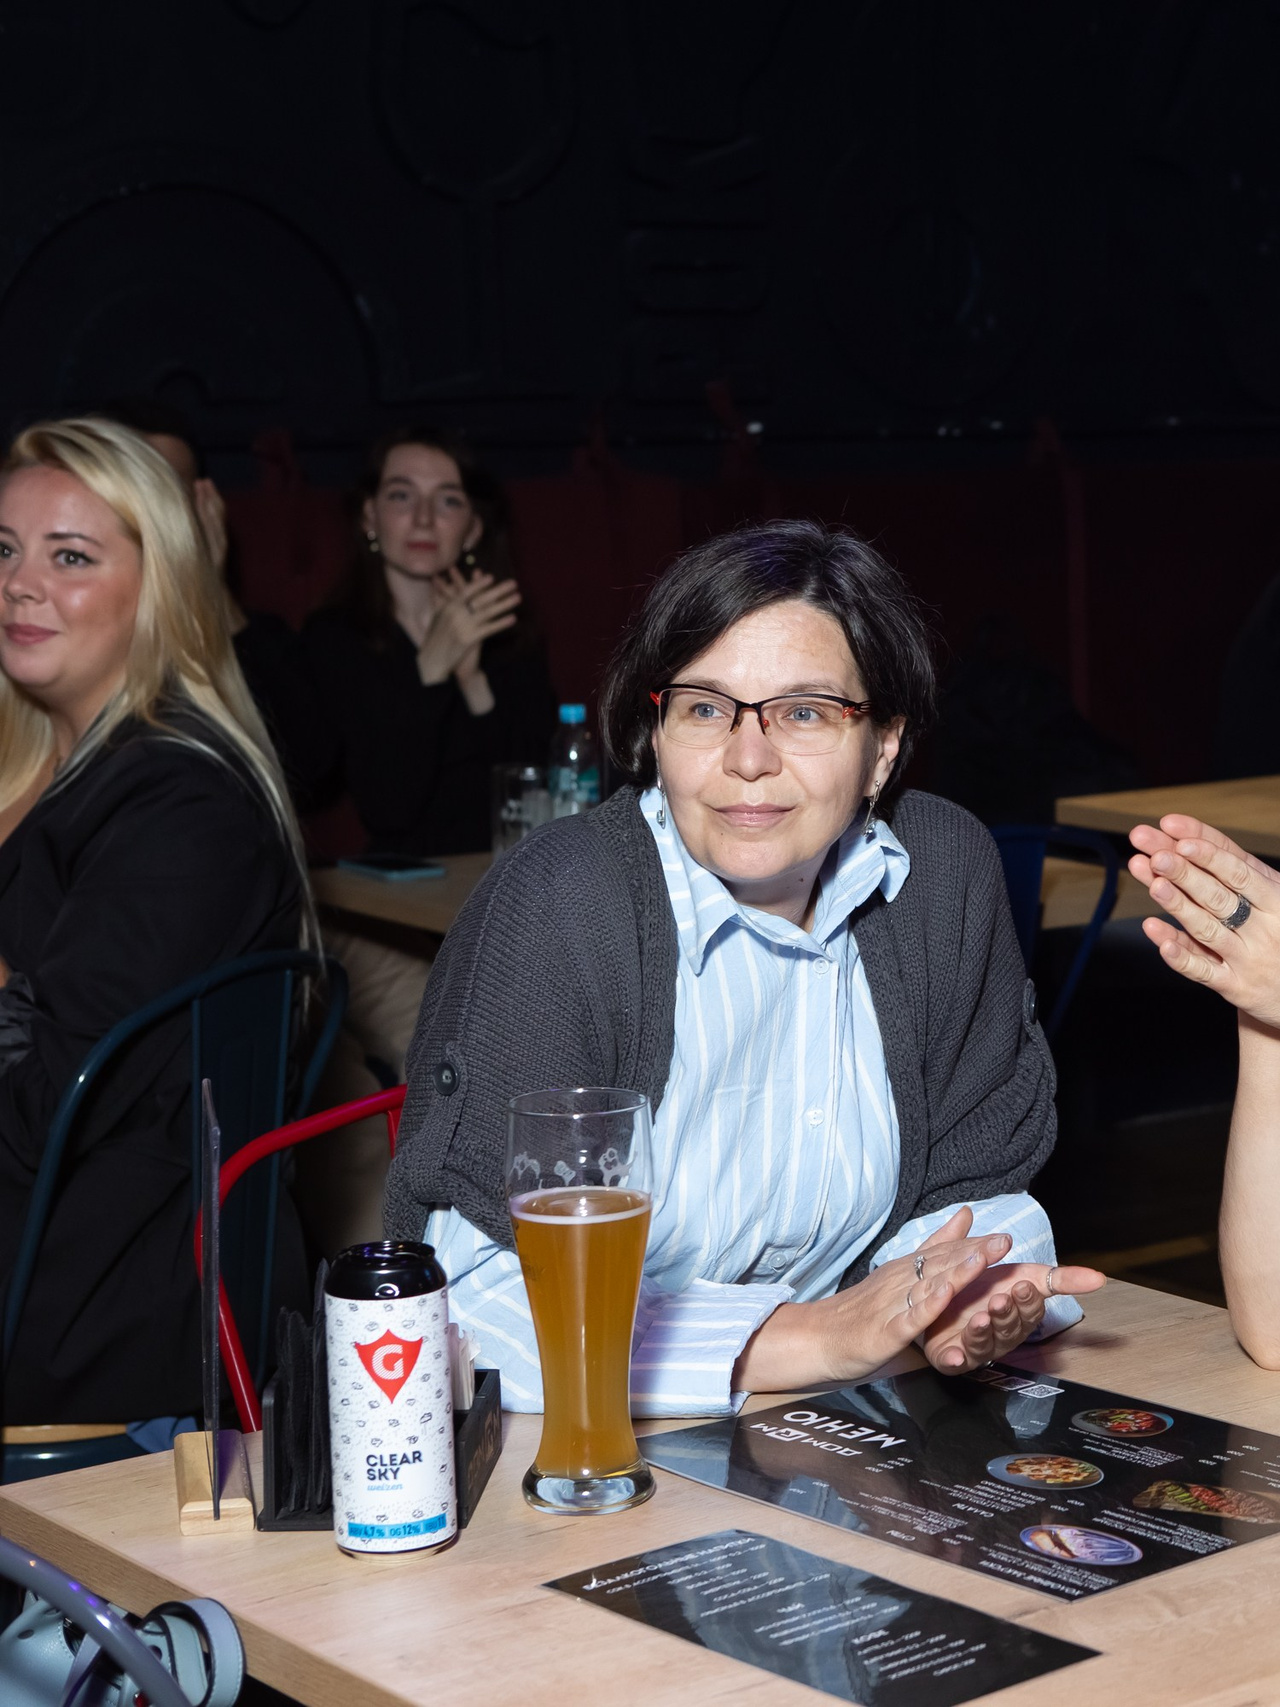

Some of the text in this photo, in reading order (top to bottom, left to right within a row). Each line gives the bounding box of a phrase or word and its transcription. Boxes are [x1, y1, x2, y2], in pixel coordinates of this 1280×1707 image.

[371, 1344, 404, 1380] G
[782, 1410, 907, 1449] МЕНЮ
[366, 1450, 423, 1467] CLEAR
[366, 1467, 400, 1481] SKY
